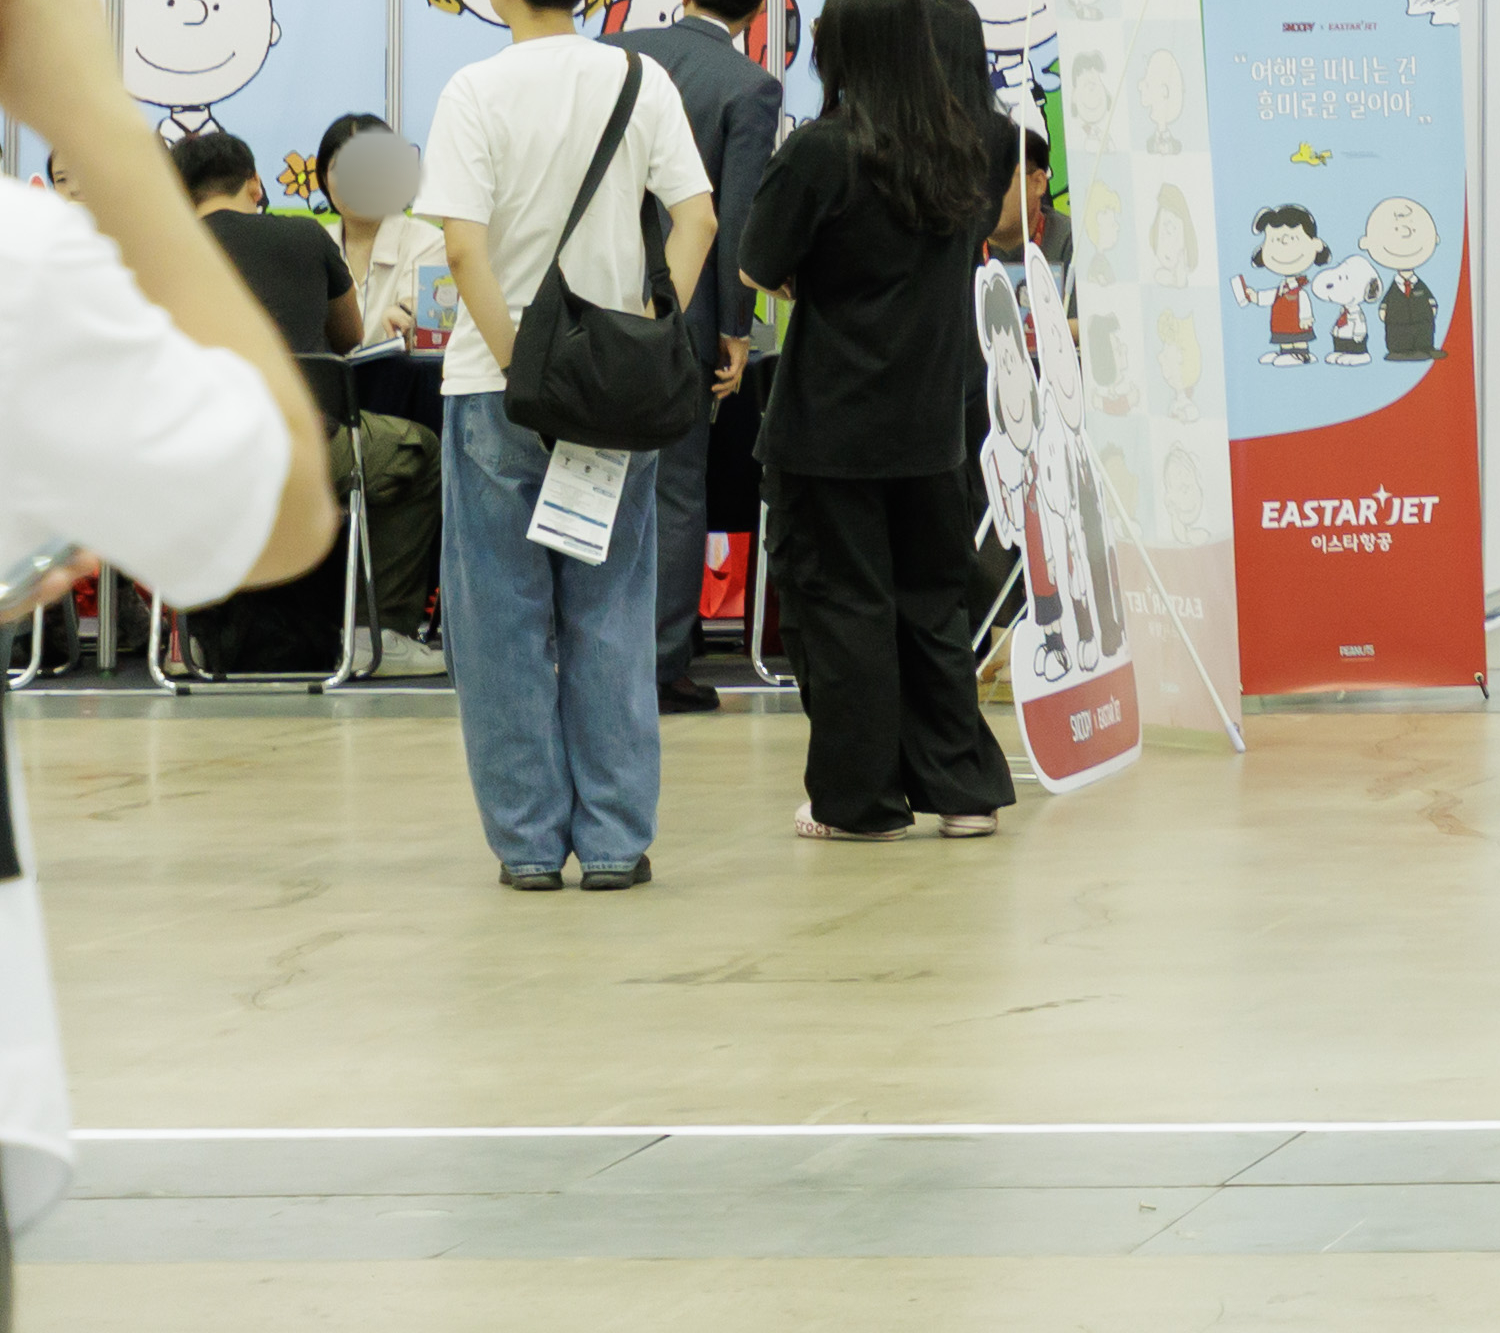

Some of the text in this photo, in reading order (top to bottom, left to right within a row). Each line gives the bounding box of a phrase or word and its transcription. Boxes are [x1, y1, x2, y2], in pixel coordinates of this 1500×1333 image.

[1324, 56, 1390, 85] 떠나는
[1396, 55, 1416, 85] 건
[1257, 89, 1339, 120] 흥미로운
[1262, 496, 1440, 529] EASTAR JET
[1311, 532, 1393, 554] 이스타항공
[794, 819, 832, 836] crocs
